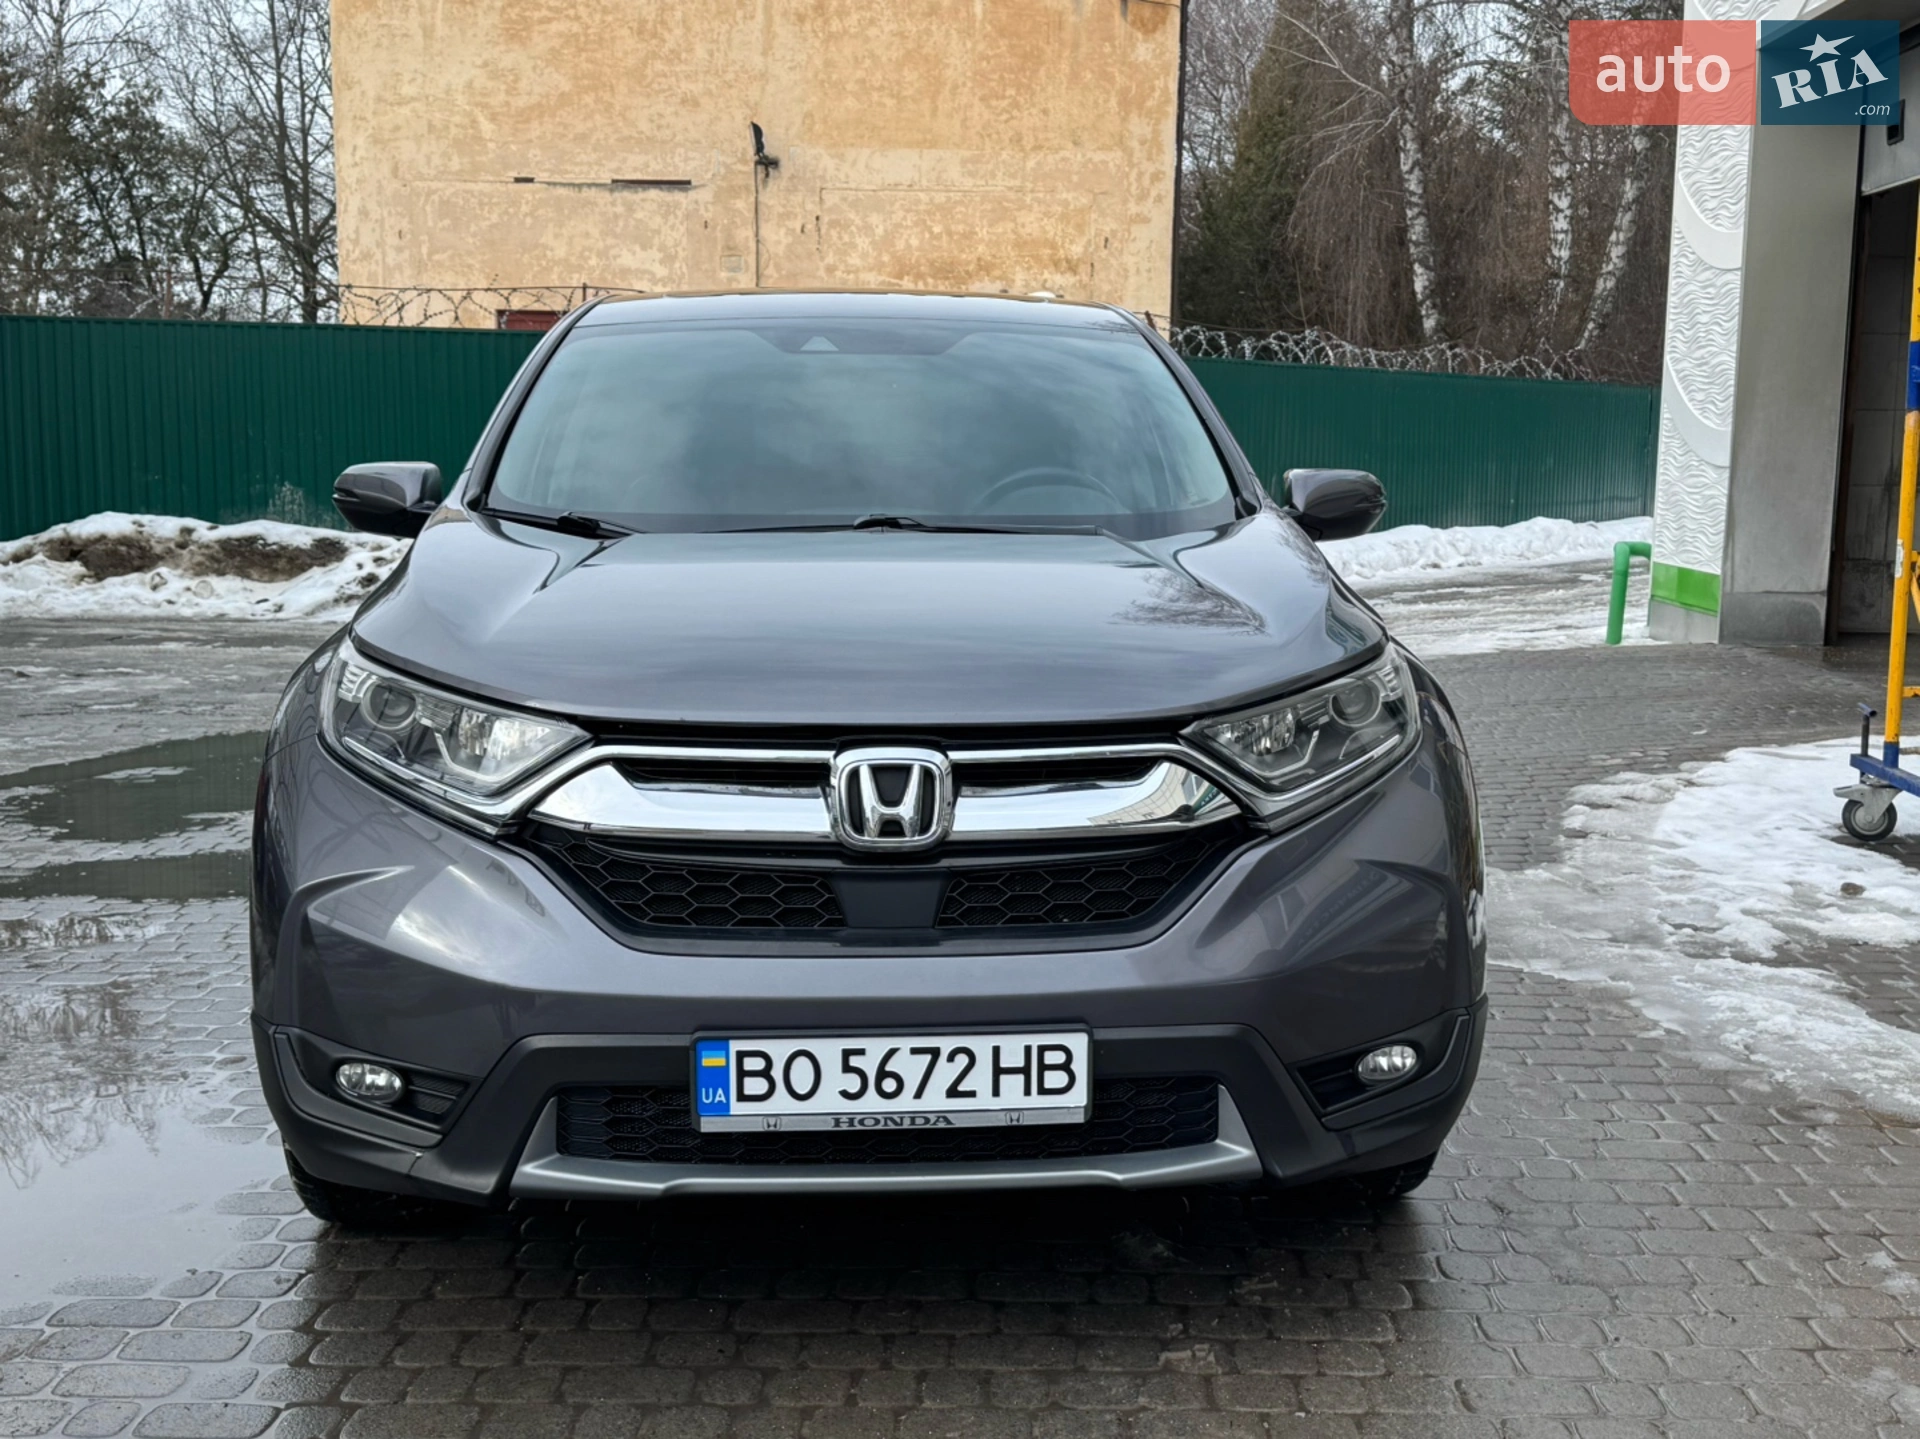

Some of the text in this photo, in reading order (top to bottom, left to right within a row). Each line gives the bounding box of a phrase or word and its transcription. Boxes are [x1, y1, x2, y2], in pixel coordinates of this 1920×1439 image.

[734, 1043, 1077, 1103] BO 5672 HB
[702, 1087, 727, 1104] UA
[830, 1115, 956, 1128] HONDA
